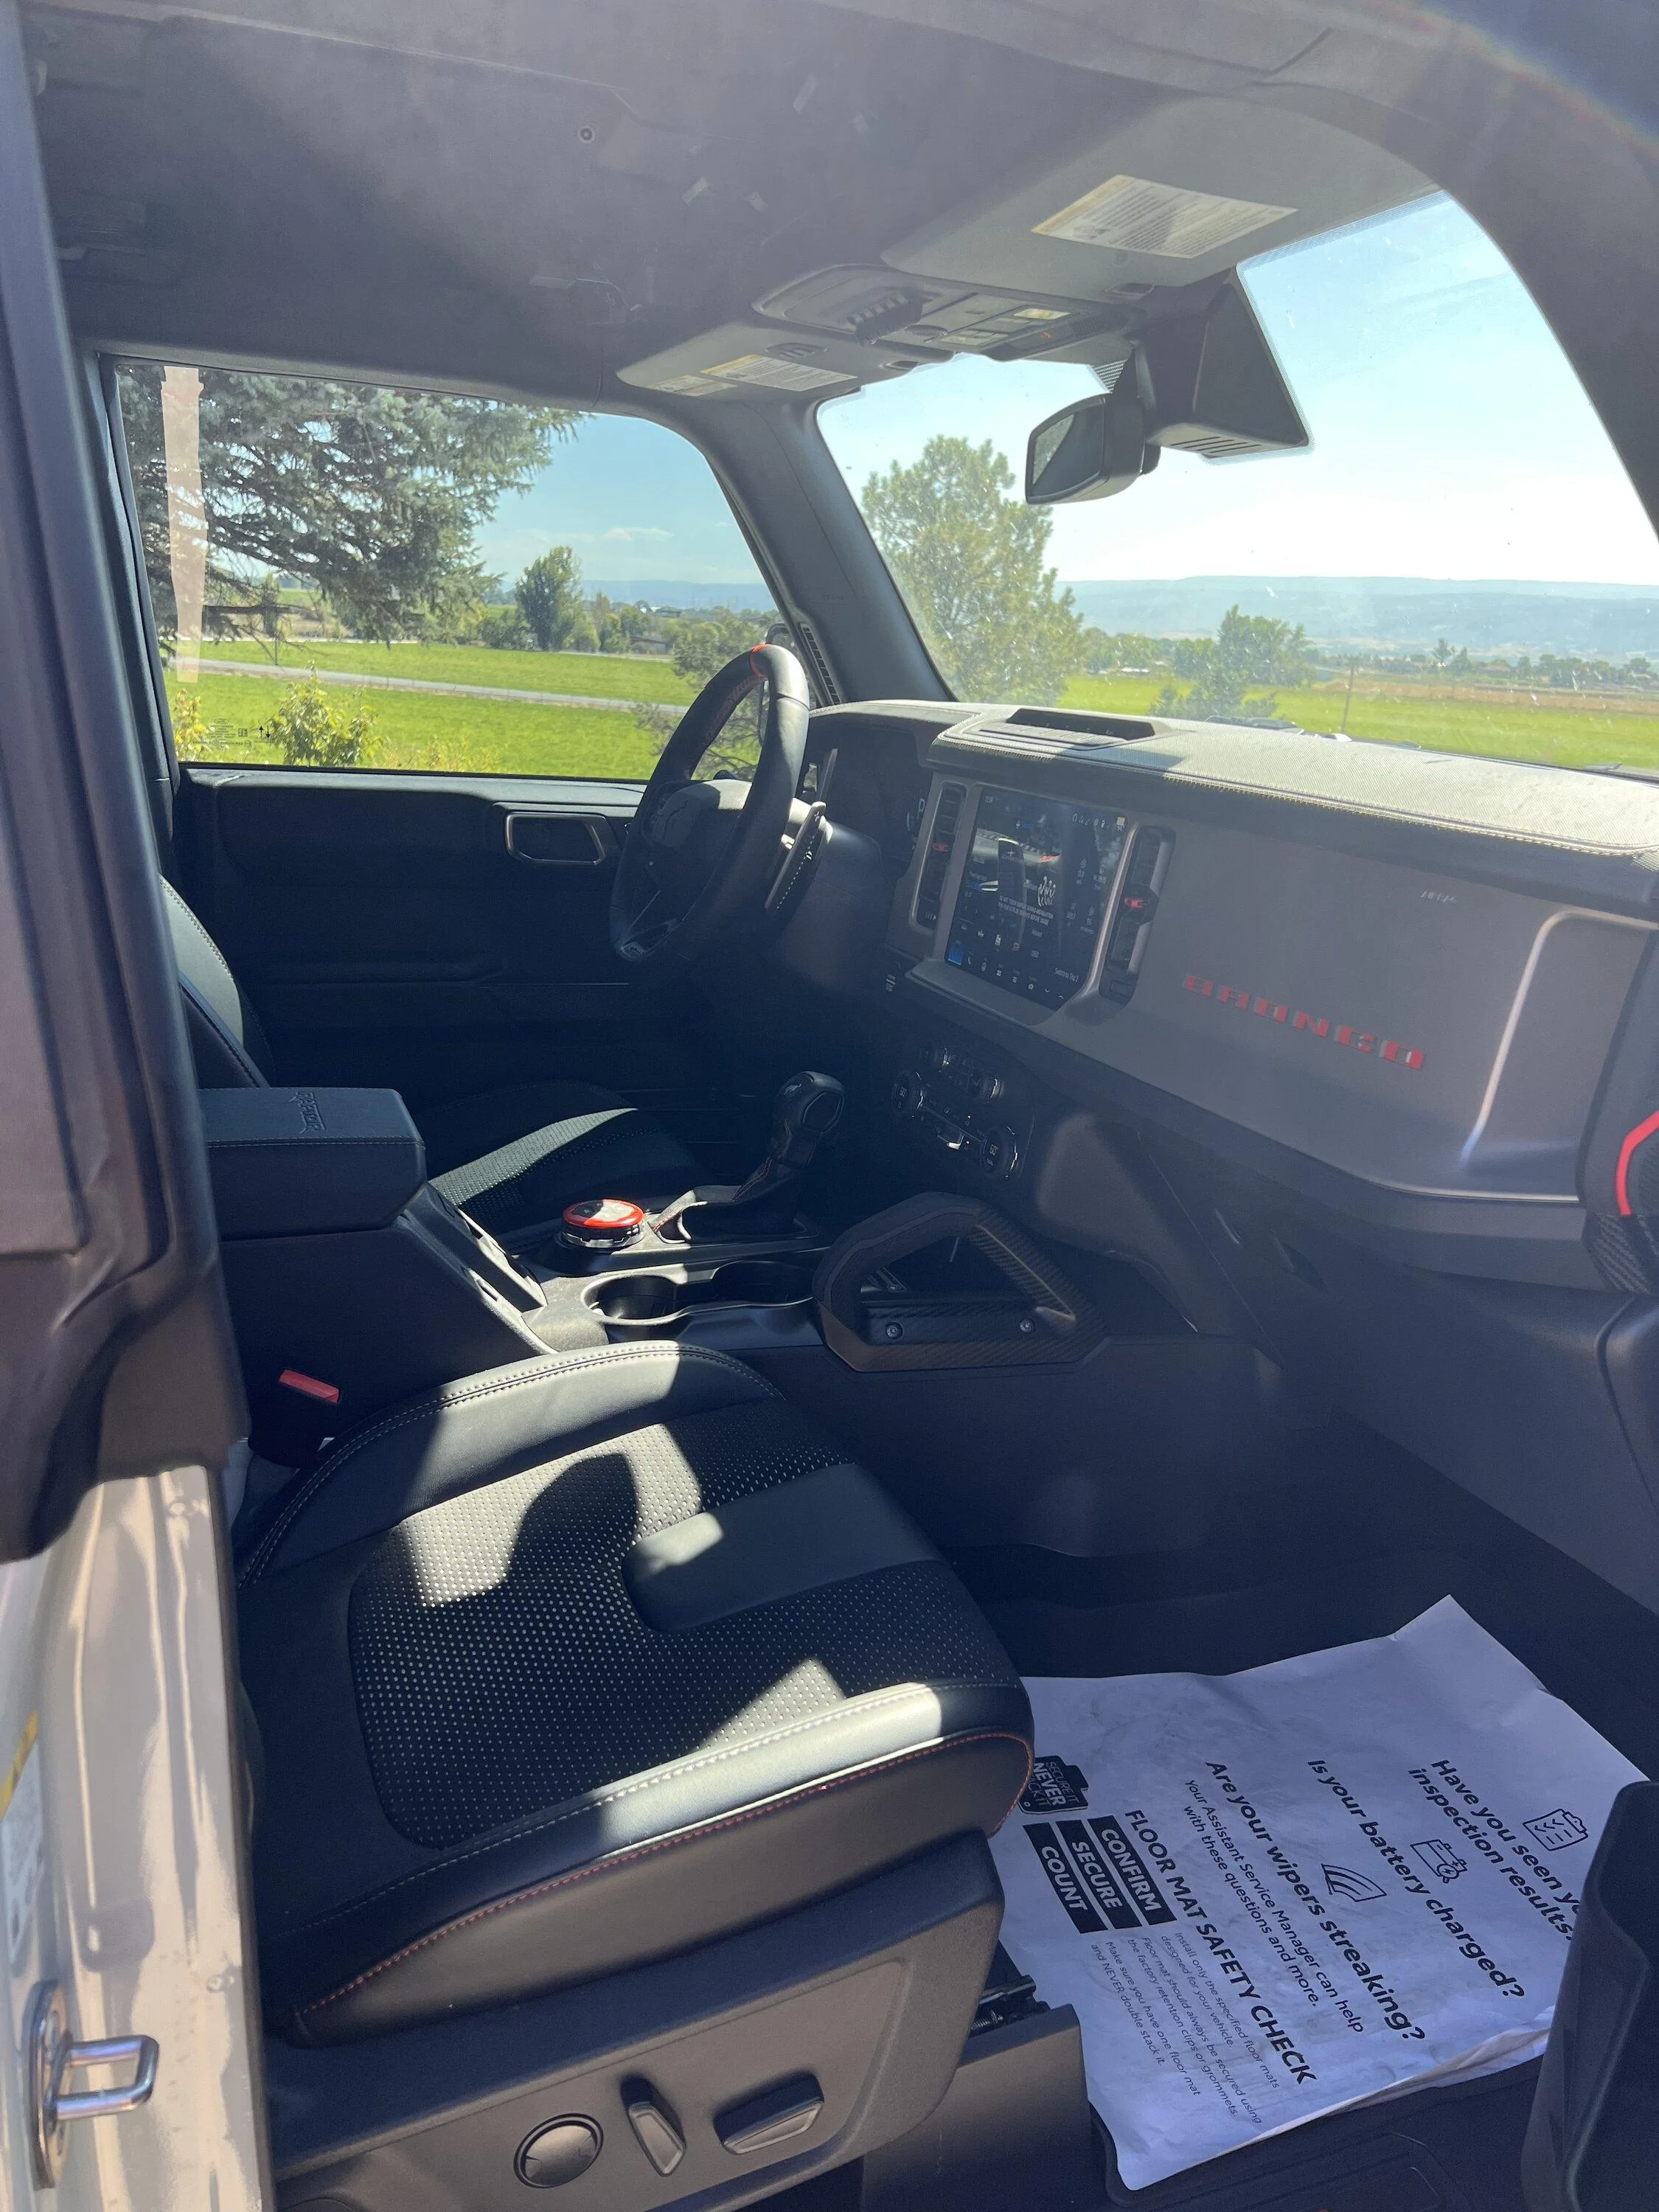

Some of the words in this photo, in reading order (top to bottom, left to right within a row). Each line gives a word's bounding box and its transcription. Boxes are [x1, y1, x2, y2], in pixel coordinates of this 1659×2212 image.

[1184, 974, 1426, 1071] BRONCO
[1034, 1763, 1066, 1806] NEVER
[1408, 1768, 1504, 1864] inspection
[1500, 1867, 1574, 1941] results
[1430, 1759, 1479, 1805] Have
[1470, 1806, 1517, 1842] you
[1512, 1845, 1562, 1891] seen
[1041, 1846, 1088, 1910] COUNT
[1071, 1841, 1123, 1908] SECURE
[1101, 1829, 1162, 1911] CONFIRM
[1184, 1806, 1205, 1832] with
[1201, 1835, 1228, 1871] these
[1225, 1873, 1272, 1934] questions
[1269, 1936, 1295, 1962] and
[1288, 1965, 1319, 2007] more.
[1186, 1780, 1207, 1804] Your
[1202, 1806, 1245, 1863] Assistant
[1239, 1863, 1276, 1908] Service
[1272, 1910, 1320, 1968] Manager
[1316, 1972, 1338, 1997] can
[1335, 2000, 1363, 2033] help
[1205, 1761, 1237, 1793] Are
[1226, 1795, 1273, 1842] your
[1267, 1846, 1325, 1916] wipers
[1320, 1921, 1425, 2039] streaking?
[1307, 1760, 1328, 1774] Is
[1318, 1775, 1366, 1818] your
[1359, 1821, 1430, 1894] battery
[1425, 1899, 1525, 1998] charged?
[1091, 1944, 1107, 1961] and
[1102, 1963, 1125, 1994] NEVER
[1120, 1994, 1144, 2028] double
[1140, 2030, 1161, 2056] stack
[1105, 1941, 1122, 1964] Make
[1119, 1966, 1135, 1986] sure
[1129, 1986, 1146, 2004] you
[1143, 2006, 1159, 2028] have
[1157, 2031, 1172, 2050] one
[1169, 2051, 1187, 2074] floor
[1183, 2076, 1201, 2096] mat
[1124, 1809, 1176, 1873] FLOOR
[1166, 1877, 1208, 1919] MAT
[1196, 1924, 1262, 2000] SAFETY
[1251, 2005, 1318, 2085] CHECK
[1127, 1939, 1140, 1953] the
[1138, 1955, 1160, 1985] factory
[1156, 1986, 1184, 2028] retention
[1181, 2029, 1198, 2051] clips
[1195, 2053, 1207, 2063] or
[1161, 1935, 1192, 1974] designed
[1187, 1976, 1200, 1989] for
[1194, 1991, 1212, 2011] your
[1175, 1933, 1197, 1958] Install
[1192, 1960, 1208, 1979] only
[1205, 1980, 1218, 1995] the
[1215, 1997, 1248, 2039] specified
[1244, 2040, 1262, 2063] floor
[1259, 2065, 1280, 2089] mats
[1141, 1937, 1159, 1958] Floor
[1156, 1960, 1171, 1977] mat
[1167, 1978, 1192, 2009] should
[1186, 2011, 1209, 2042] always
[1206, 2044, 1217, 2057] be
[1215, 2059, 1246, 2096] secured
[1241, 2098, 1262, 2124] using
